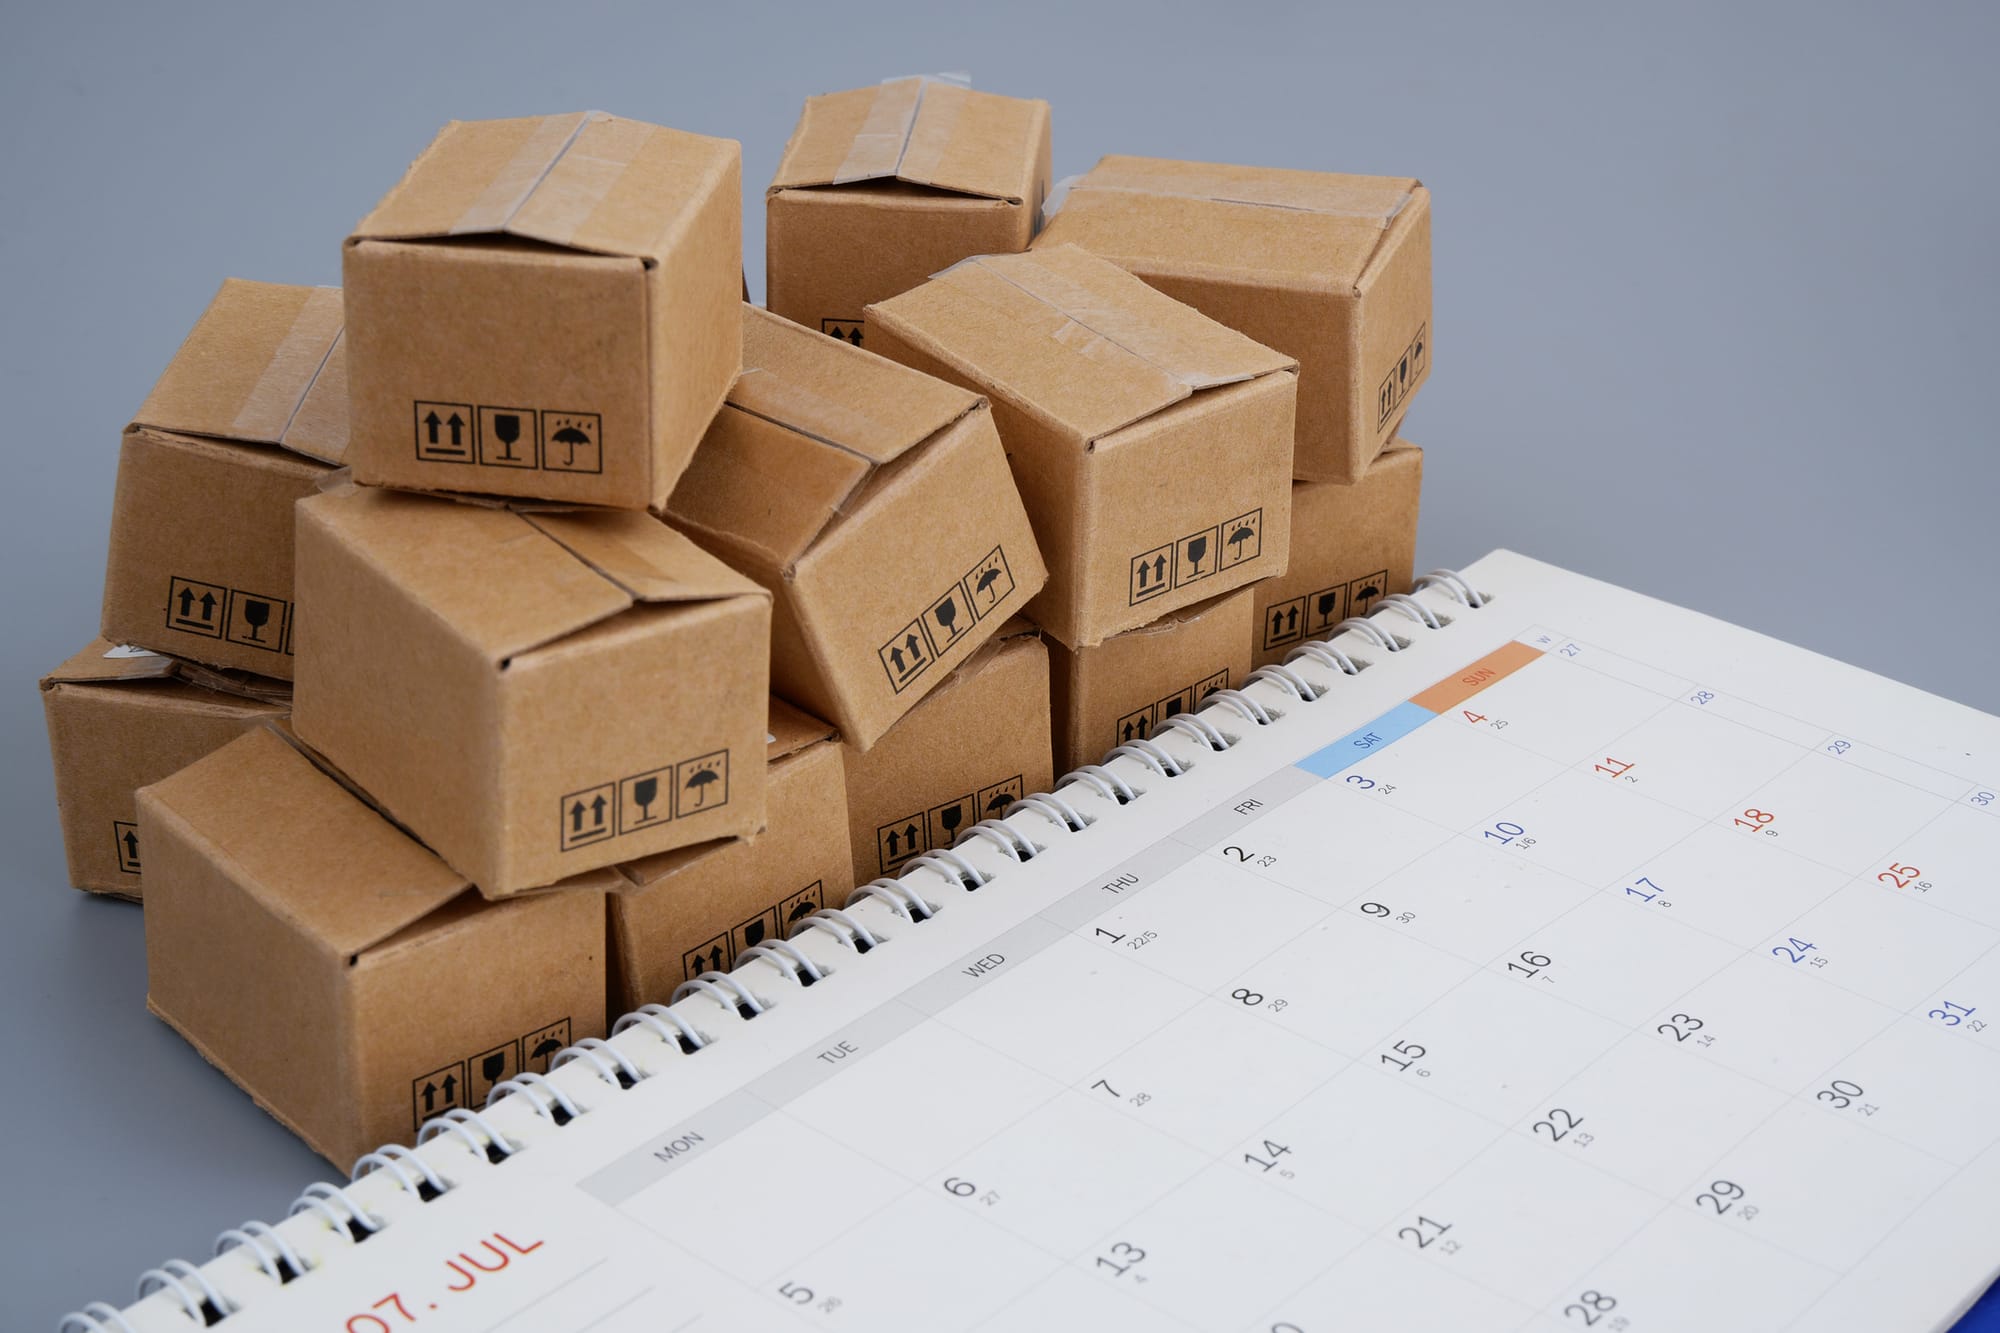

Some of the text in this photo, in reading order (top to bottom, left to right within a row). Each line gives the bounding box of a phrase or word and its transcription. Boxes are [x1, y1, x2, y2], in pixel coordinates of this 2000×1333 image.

[1559, 643, 1581, 657] 27
[1461, 667, 1497, 687] SUN
[1690, 690, 1715, 705] 28
[1463, 710, 1488, 724] 4
[1489, 719, 1509, 730] 25
[1353, 731, 1383, 749] SAT
[1827, 740, 1852, 755] 29
[1594, 757, 1635, 779] 11
[1346, 775, 1376, 790] 3
[1624, 775, 1638, 784] 2
[1377, 784, 1396, 795] 24
[1970, 791, 1996, 806] 30
[1233, 798, 1264, 816] FRI
[1734, 808, 1775, 833] 18
[1484, 822, 1525, 845] 10
[1765, 829, 1779, 838] 9
[1223, 846, 1255, 863] 2
[1256, 855, 1277, 868] 23
[1101, 872, 1139, 894] THU
[1877, 862, 1921, 889] 25
[1625, 877, 1664, 903] 17
[1914, 879, 1933, 894] 16
[1360, 902, 1391, 918] 9
[1657, 900, 1672, 908] 8
[1395, 911, 1416, 924] 30
[1095, 927, 1127, 944] 1
[1127, 930, 1158, 951] 22/5
[1771, 937, 1817, 965] 24
[962, 953, 1006, 978] WED
[1507, 951, 1552, 979] 16
[1809, 956, 1829, 969] 15
[1541, 975, 1555, 984] 7
[1231, 988, 1264, 1006] 8
[1267, 998, 1289, 1013] 29
[1928, 1000, 1977, 1029] 31
[1657, 1013, 1704, 1043] 23
[1966, 1019, 1988, 1033] 22
[1696, 1034, 1716, 1048] 14
[816, 1040, 859, 1064] TUE
[1381, 1039, 1427, 1072] 15
[1415, 1068, 1431, 1078] 6
[1090, 1079, 1121, 1098] 7
[1816, 1080, 1864, 1109] 30
[1129, 1092, 1152, 1108] 28
[1857, 1103, 1880, 1117] 21
[1532, 1108, 1584, 1142] 22
[653, 1131, 705, 1162] MON
[1244, 1139, 1292, 1172] 14
[943, 1177, 977, 1197] 6
[1695, 1180, 1745, 1216] 29
[1398, 1215, 1452, 1249] 21
[446, 1232, 544, 1292] JUL
[1096, 1242, 1147, 1277] 13
[778, 1282, 815, 1305] 5
[1564, 1290, 1617, 1327] 28
